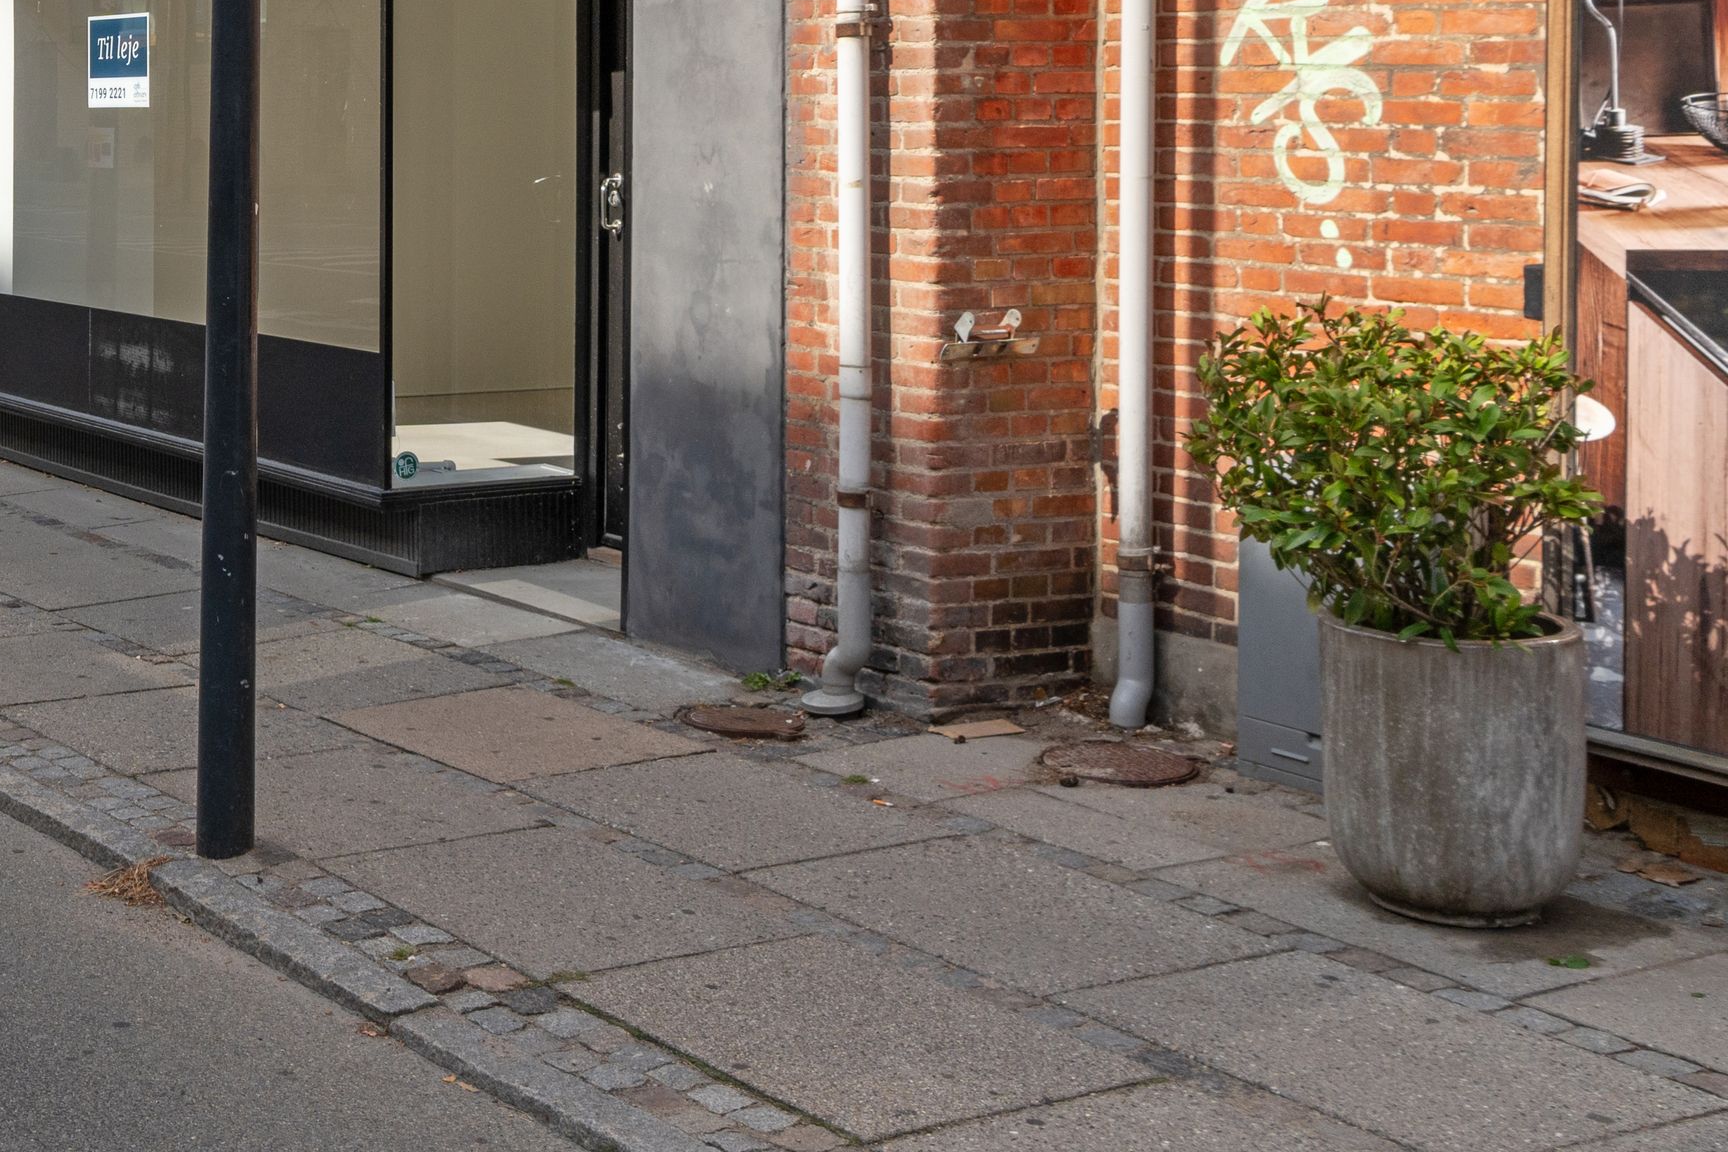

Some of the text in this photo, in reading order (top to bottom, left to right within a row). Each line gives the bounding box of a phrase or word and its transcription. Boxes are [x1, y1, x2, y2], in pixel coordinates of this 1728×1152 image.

[97, 34, 140, 66] Til leje
[90, 88, 107, 99] 7199
[109, 87, 126, 99] 2221
